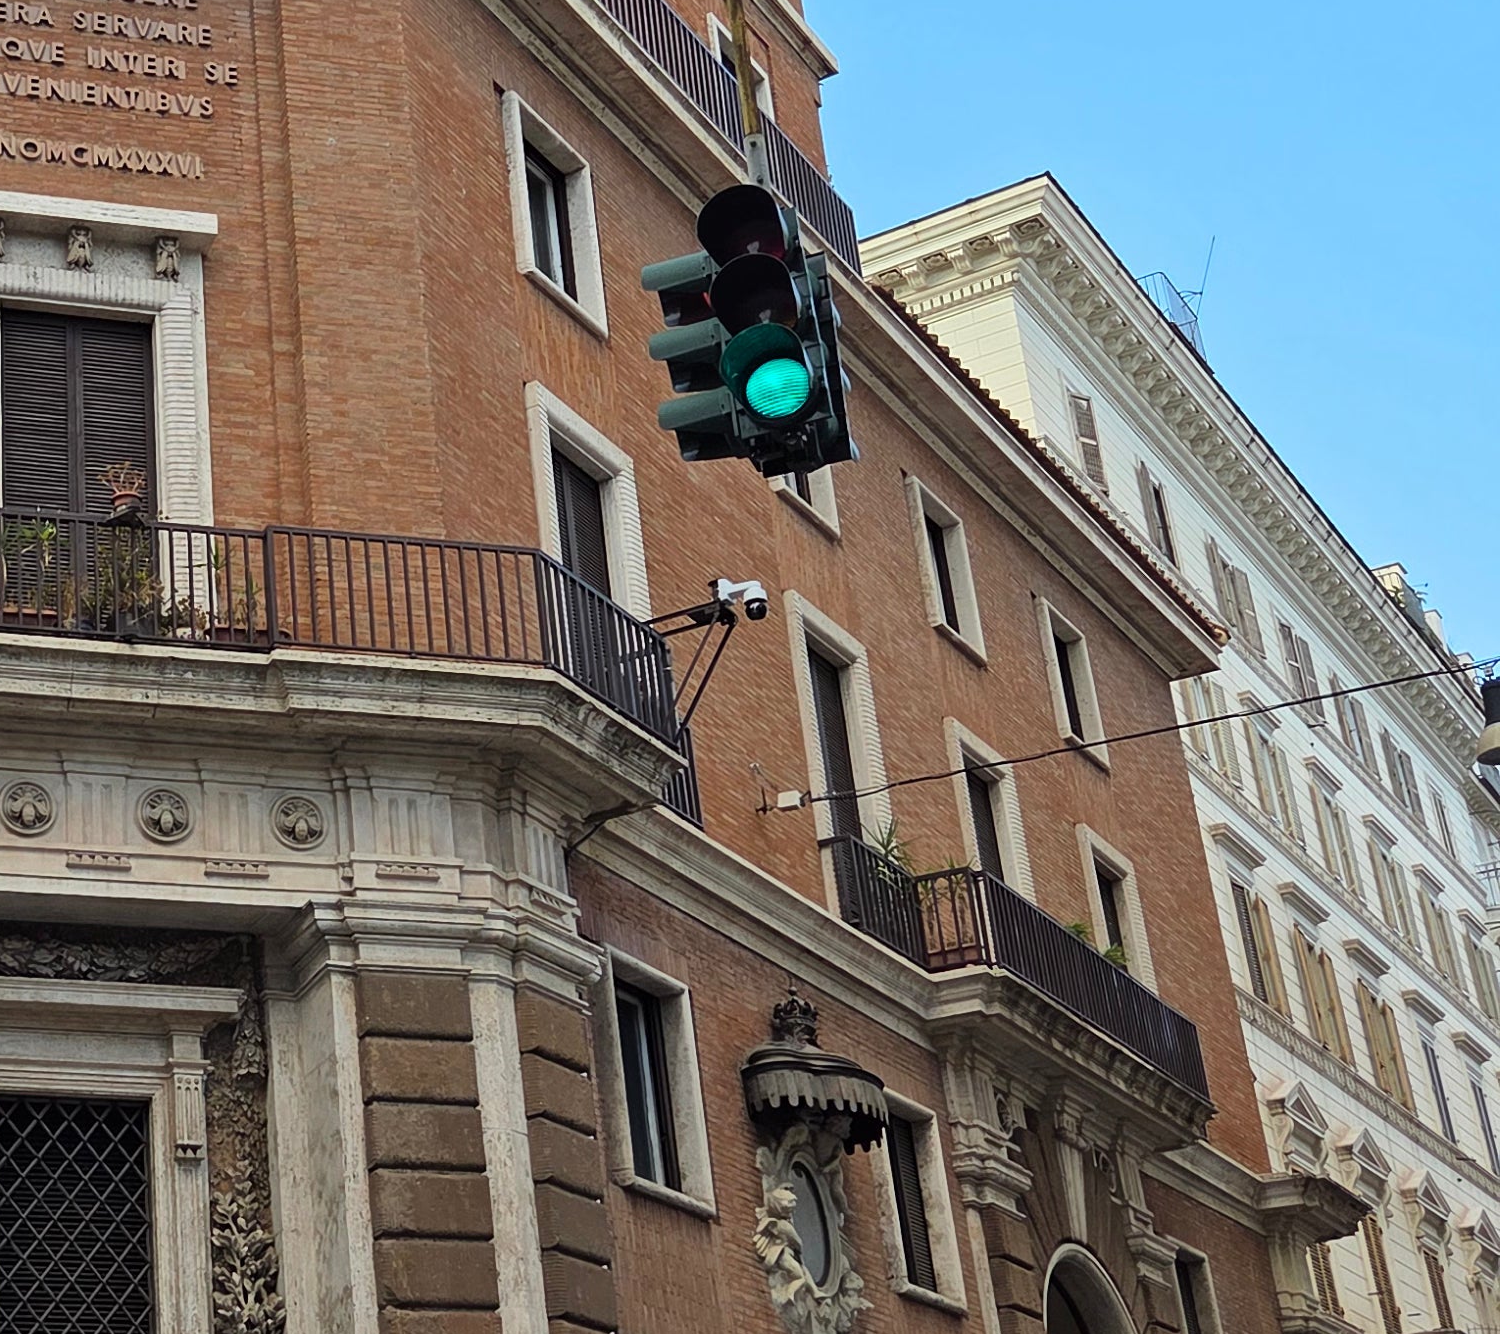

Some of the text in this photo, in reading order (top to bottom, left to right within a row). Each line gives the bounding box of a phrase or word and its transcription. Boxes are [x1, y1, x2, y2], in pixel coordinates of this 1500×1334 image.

[73, 10, 212, 47] SERVARE
[87, 46, 186, 80] INTER
[204, 61, 238, 86] SE
